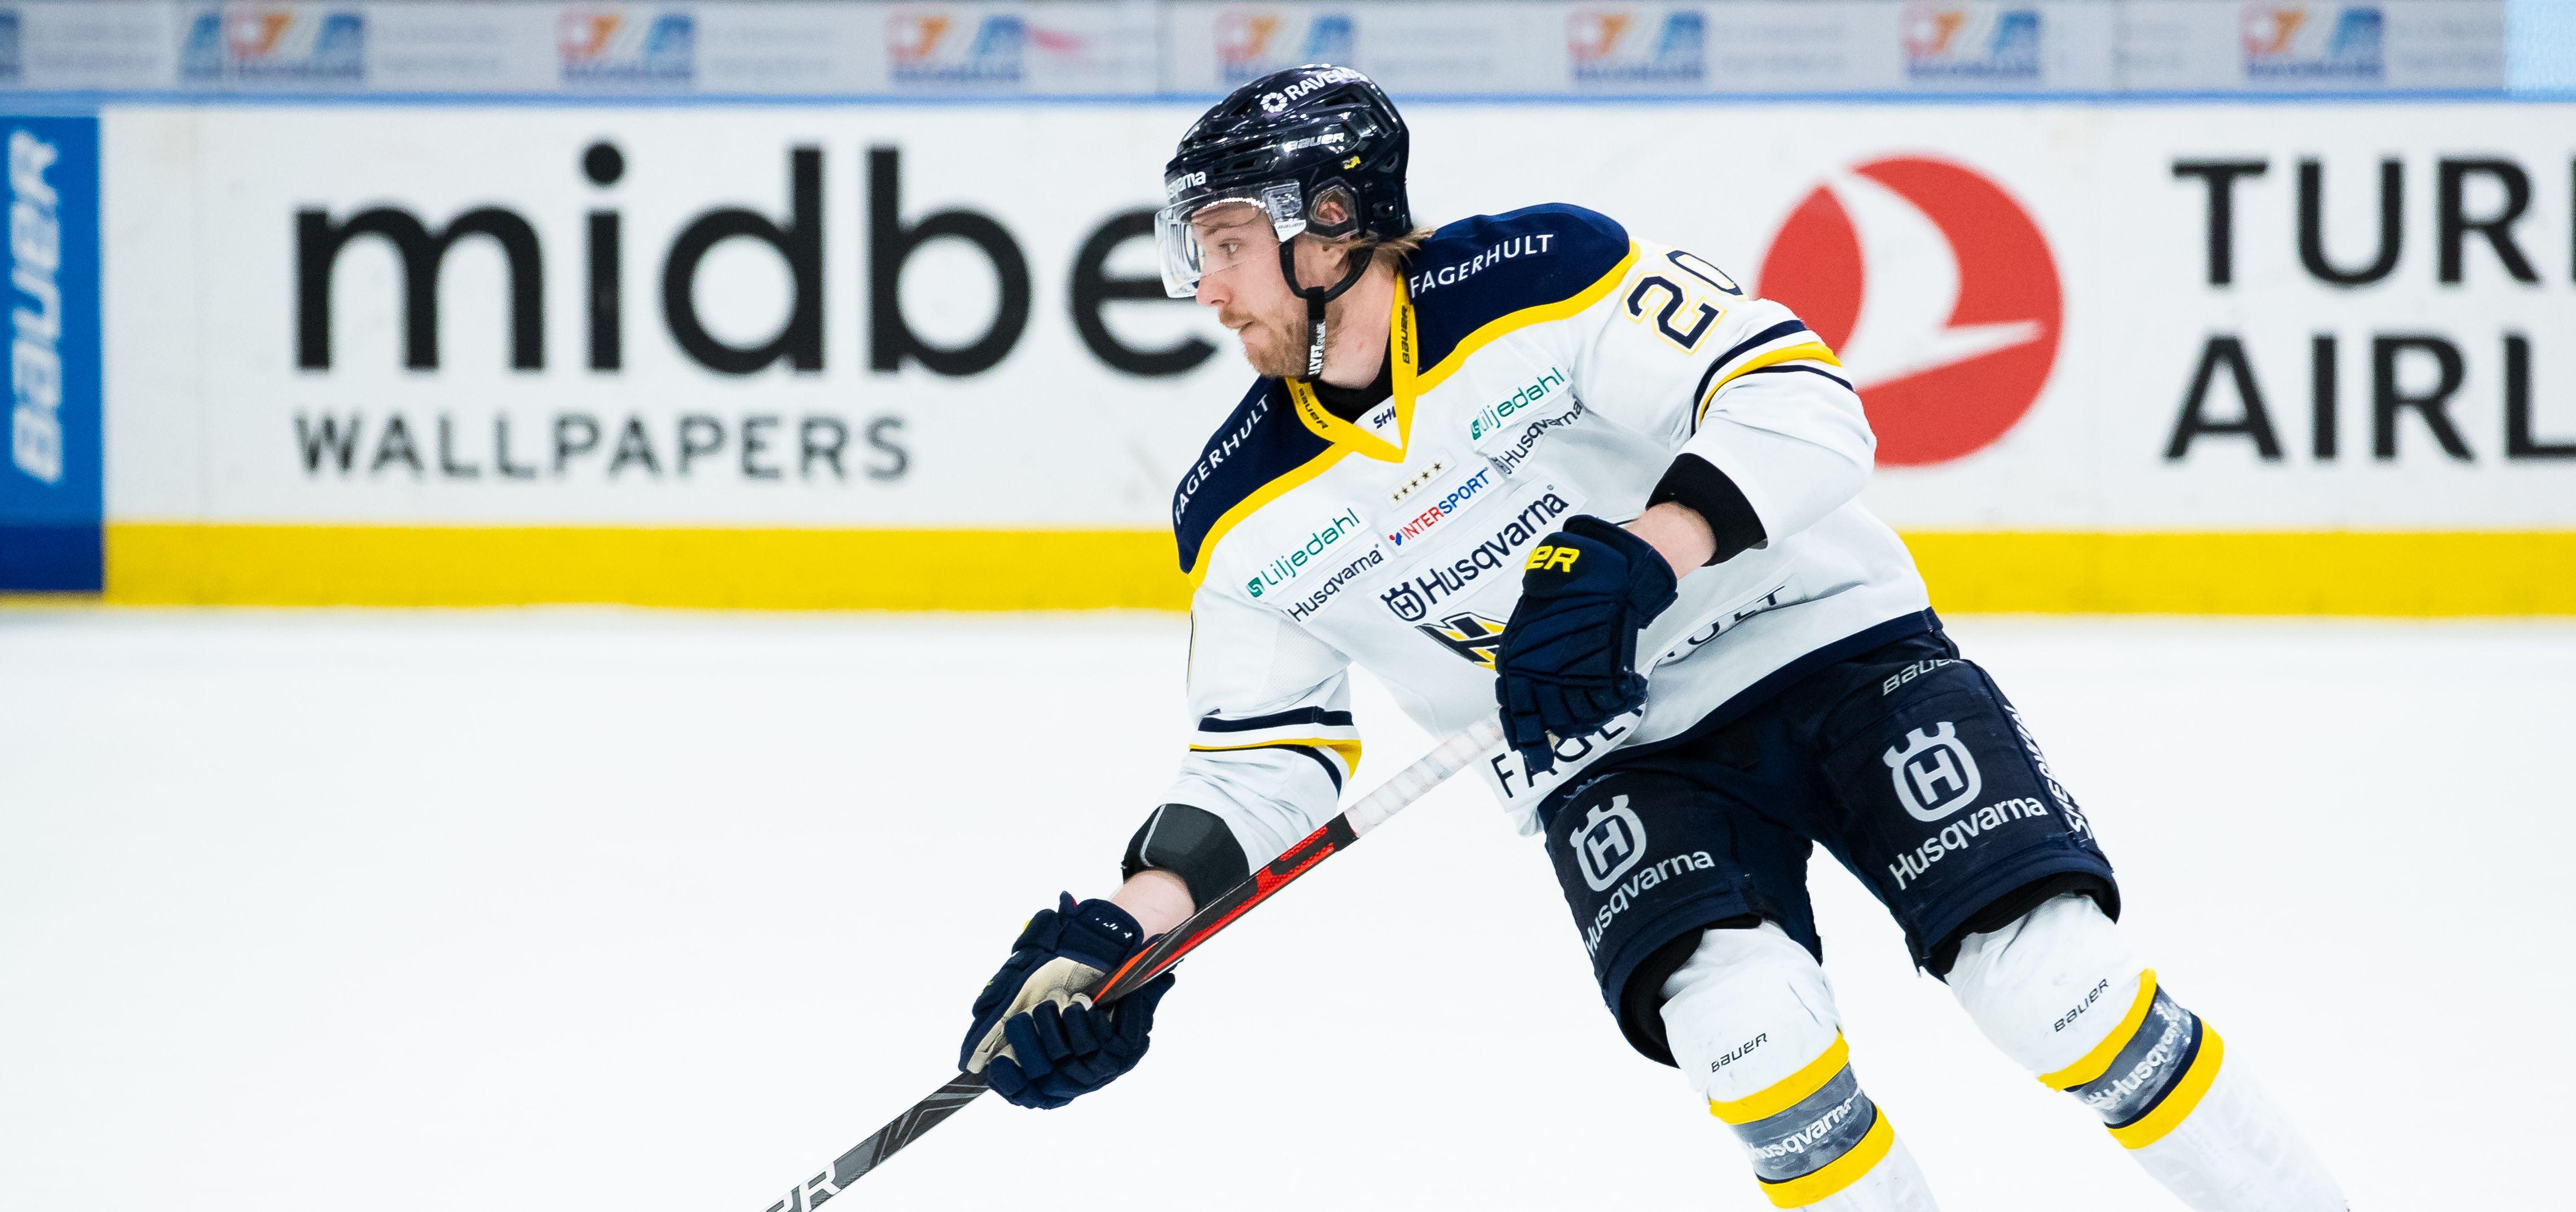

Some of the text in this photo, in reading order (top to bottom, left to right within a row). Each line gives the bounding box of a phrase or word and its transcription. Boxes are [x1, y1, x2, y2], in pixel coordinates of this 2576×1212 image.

[2170, 155, 2576, 289] TUR
[1410, 234, 1554, 298] FAGERHULT
[1622, 247, 1749, 355] 20
[1477, 367, 1565, 432] iljedahl
[293, 412, 910, 481] WALLPAPERS
[1174, 394, 1271, 525] FAGERHULT
[1261, 507, 1361, 587] Liljedahl
[1399, 468, 1489, 540] INTERSPORT
[1287, 548, 1384, 622] Husqvarna
[1415, 493, 1570, 605] Husqvarna
[1887, 796, 2049, 890] Husqvarna
[1585, 851, 1716, 958] Husqvarna
